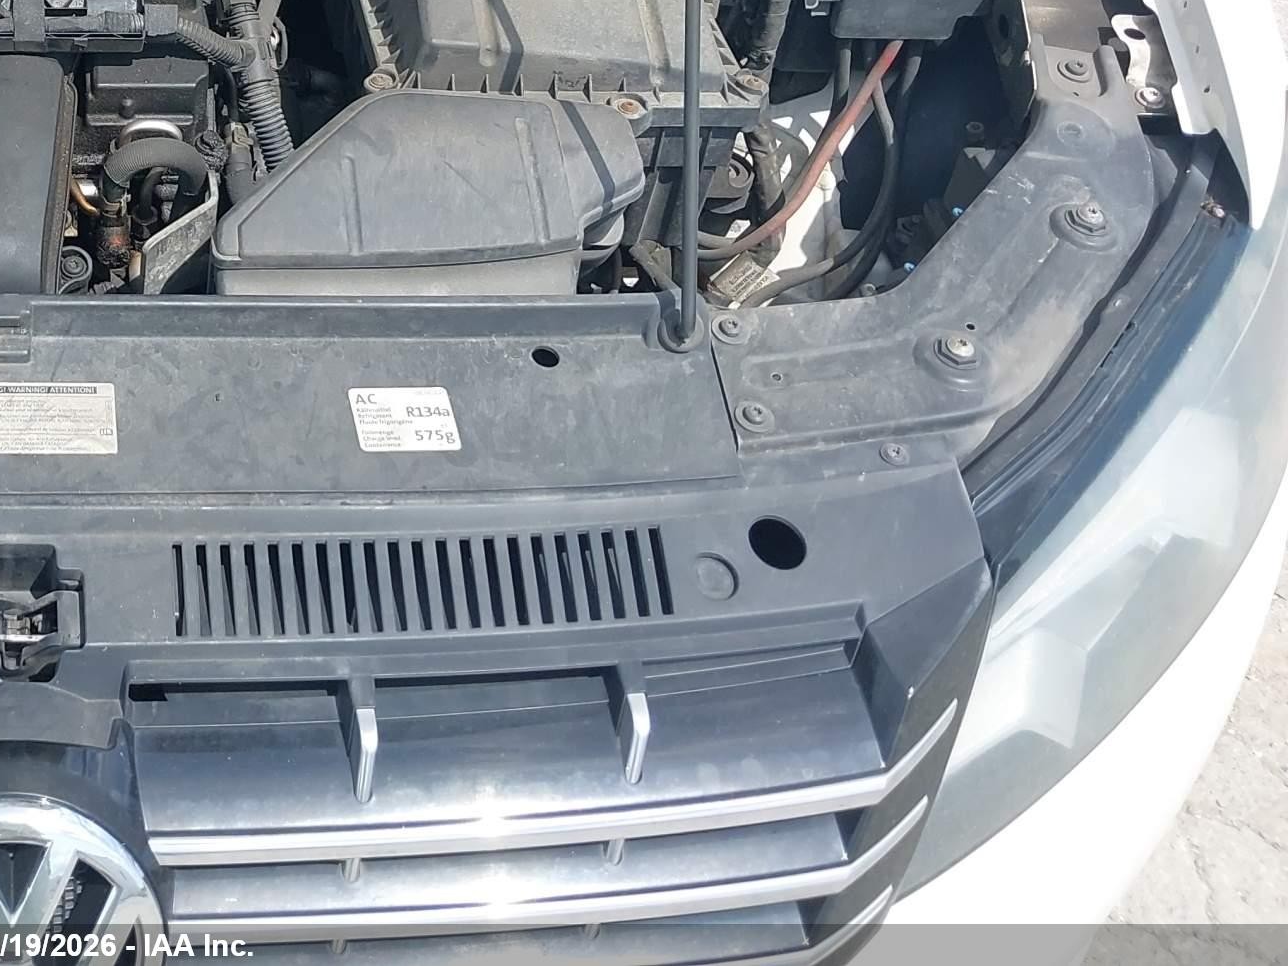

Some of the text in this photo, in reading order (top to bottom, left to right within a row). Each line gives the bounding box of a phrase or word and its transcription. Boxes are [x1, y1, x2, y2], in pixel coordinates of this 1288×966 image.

[7, 386, 49, 394] WARNING!
[50, 386, 95, 394] ATTENTION!
[355, 393, 378, 405] AC
[405, 406, 450, 418] R134a
[414, 429, 456, 444] 575g
